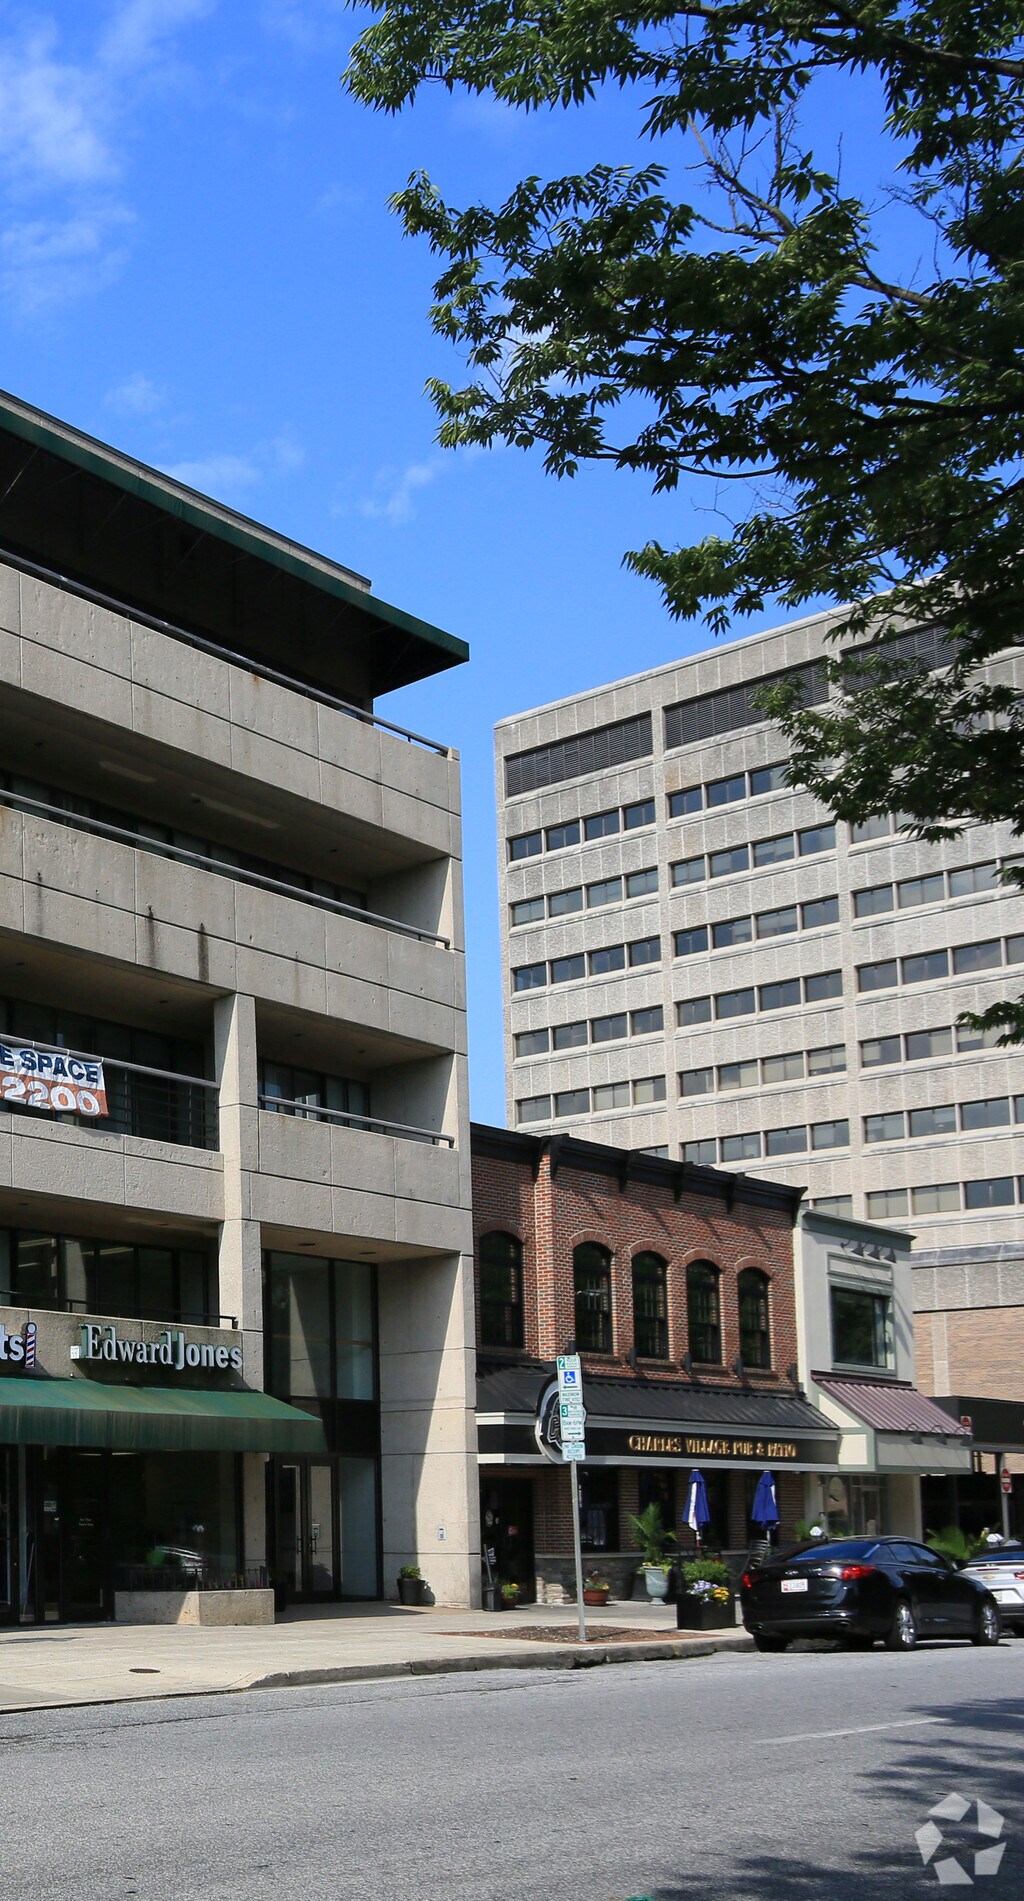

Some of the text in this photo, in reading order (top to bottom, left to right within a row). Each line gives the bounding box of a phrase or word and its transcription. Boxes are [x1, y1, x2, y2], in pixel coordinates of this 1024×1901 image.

[19, 1050, 99, 1083] SPACE
[83, 1323, 244, 1371] Edward Jones
[561, 1406, 568, 1417] 3
[629, 1435, 682, 1452] CHARLES
[685, 1437, 730, 1454] VILLAGE
[733, 1440, 753, 1456] PUB
